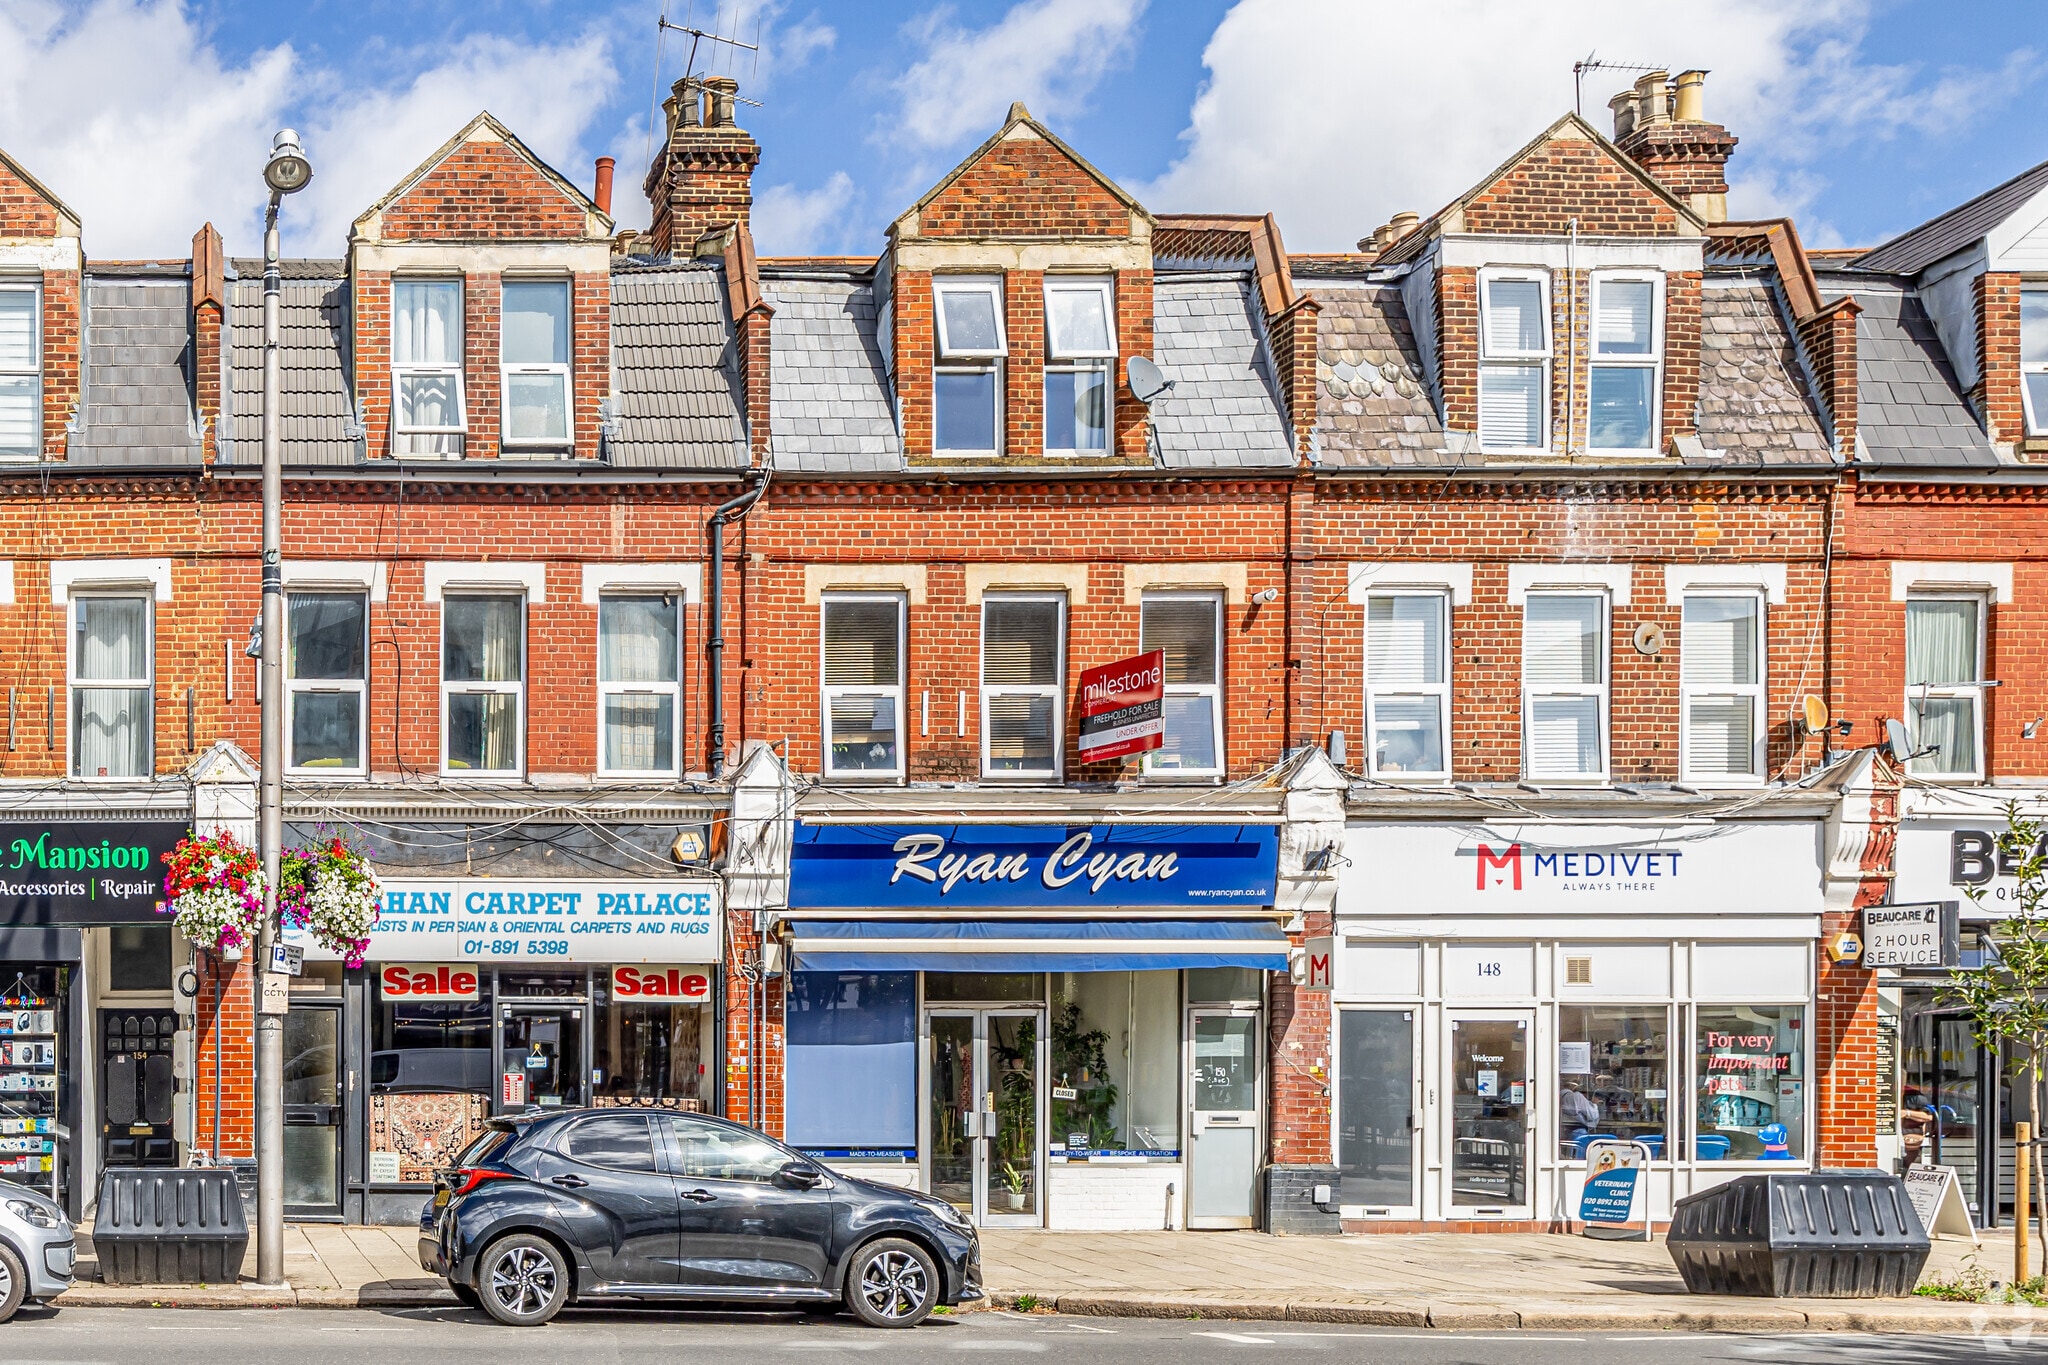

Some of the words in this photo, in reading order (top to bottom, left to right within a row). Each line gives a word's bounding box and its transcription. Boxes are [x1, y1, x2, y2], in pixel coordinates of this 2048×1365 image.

[1084, 666, 1161, 701] milestone
[1084, 696, 1117, 709] COMMERCIAL
[1093, 709, 1128, 725] FREEHOLD
[1128, 705, 1142, 716] FOR
[1143, 701, 1159, 712] SALE
[1115, 728, 1138, 738] UNDER
[1138, 722, 1159, 733] OFFER
[10, 832, 149, 872] Mansion
[891, 833, 1029, 895] Ryan
[1043, 832, 1179, 894] Cyan
[1534, 852, 1683, 877] MEDIVET
[0, 880, 86, 896] Accessories
[100, 879, 156, 900] Repair
[1188, 888, 1267, 899] www.ryancyan.co.uk
[1562, 882, 1612, 891] ALWAYS
[1617, 882, 1656, 891] THERE
[465, 892, 582, 915] CARPET
[597, 893, 711, 916] PALACE
[1867, 911, 1922, 925] BEAUCARE
[411, 921, 425, 932] IN
[429, 921, 486, 933] PERSIAN
[489, 921, 499, 933] &
[503, 921, 565, 933] ORIENTAL
[570, 922, 632, 934] CARPETS
[636, 922, 666, 934] AND
[670, 922, 710, 934] RUGS
[464, 939, 519, 955] 01-891
[527, 940, 569, 955] 5398
[1874, 935, 1882, 947] 2
[1886, 933, 1931, 947] HOUR
[1866, 949, 1937, 964] SERVICE
[1310, 953, 1329, 987] M
[1477, 962, 1502, 977] 148
[383, 967, 477, 995] Sale
[614, 967, 708, 996] Sale
[264, 989, 287, 997] CCTV
[1707, 1031, 1736, 1048] For
[1738, 1035, 1775, 1052] very
[133, 1051, 148, 1060] 154
[1471, 1054, 1505, 1063] Welcome
[1708, 1054, 1789, 1074] important
[1055, 1089, 1075, 1098] CLOSED
[1708, 1077, 1747, 1095] pets.
[1594, 1180, 1633, 1189] VETERINARY
[1908, 1172, 1938, 1182] BEAUCARE
[1609, 1189, 1631, 1197] CLINIC
[1584, 1197, 1596, 1205] 020
